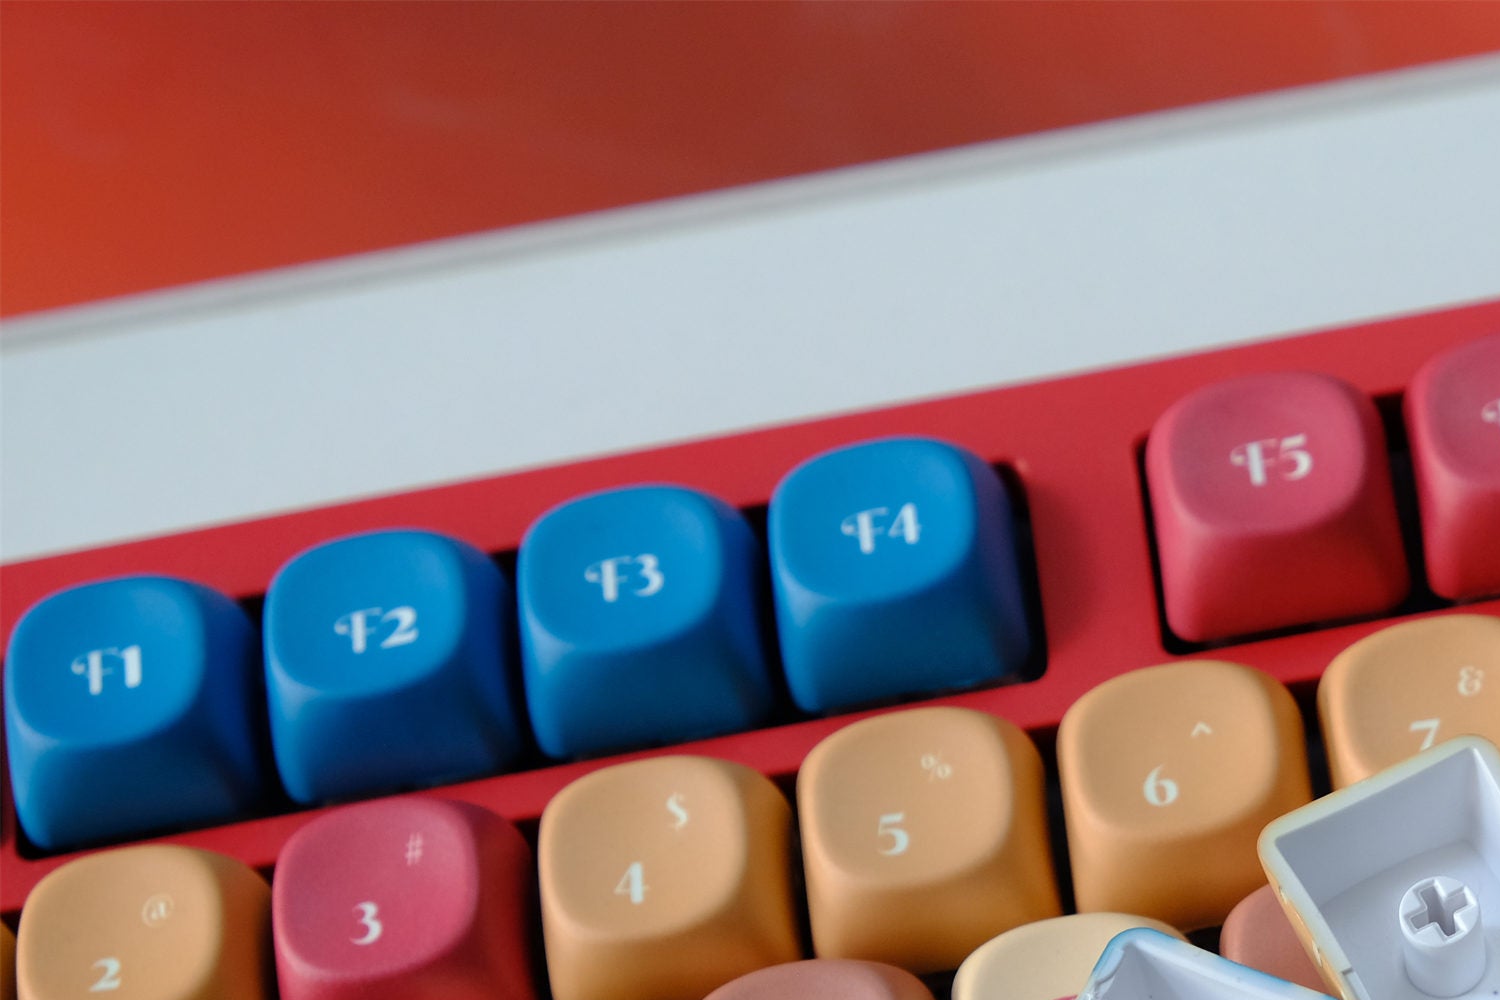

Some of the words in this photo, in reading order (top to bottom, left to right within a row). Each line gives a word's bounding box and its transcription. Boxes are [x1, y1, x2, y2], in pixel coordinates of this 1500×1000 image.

[1231, 434, 1312, 485] F5
[841, 504, 919, 554] F4
[585, 554, 663, 602] F3
[335, 607, 417, 653] F2
[71, 646, 141, 695] F1
[1409, 718, 1440, 751] 7
[921, 754, 953, 780] %
[1143, 767, 1179, 806] 6
[666, 794, 688, 829] $
[405, 834, 423, 865] #
[878, 813, 909, 855] 5
[615, 862, 648, 904] 4
[142, 894, 174, 927] @
[349, 902, 382, 944] 3
[90, 957, 121, 992] 2
